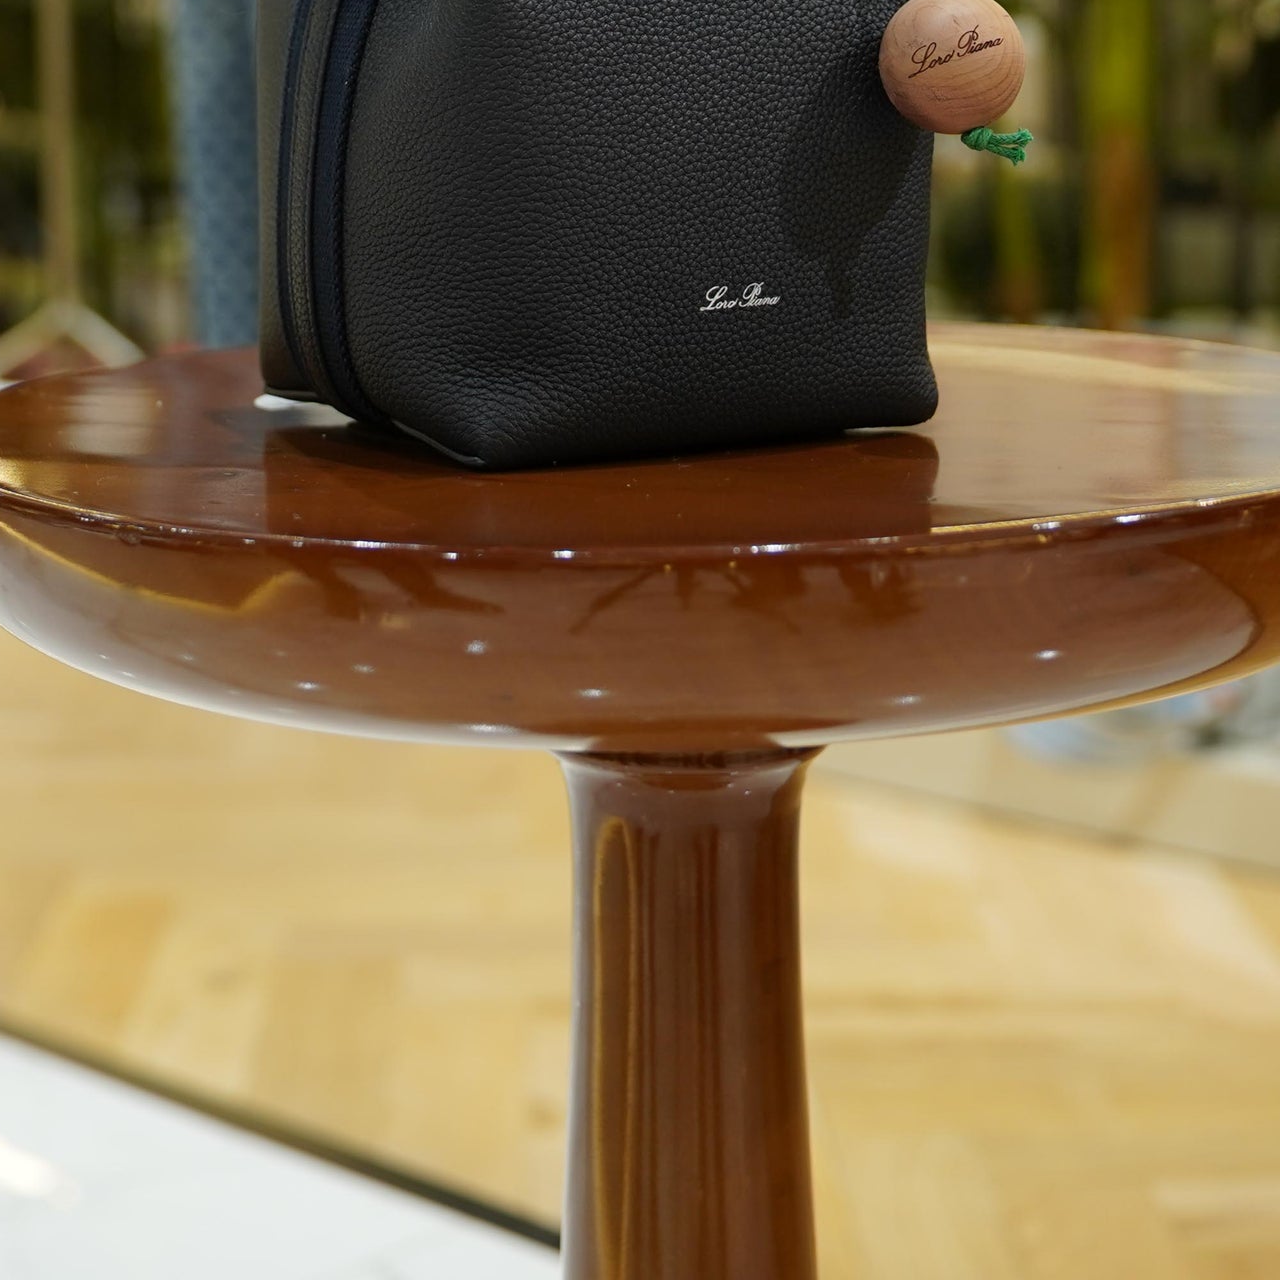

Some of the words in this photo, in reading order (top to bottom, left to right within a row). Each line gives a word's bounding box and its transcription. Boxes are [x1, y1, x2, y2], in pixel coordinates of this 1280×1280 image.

[908, 42, 955, 79] Loro
[957, 24, 1005, 58] Piana
[700, 285, 739, 312] Loro
[739, 281, 781, 308] Piana
